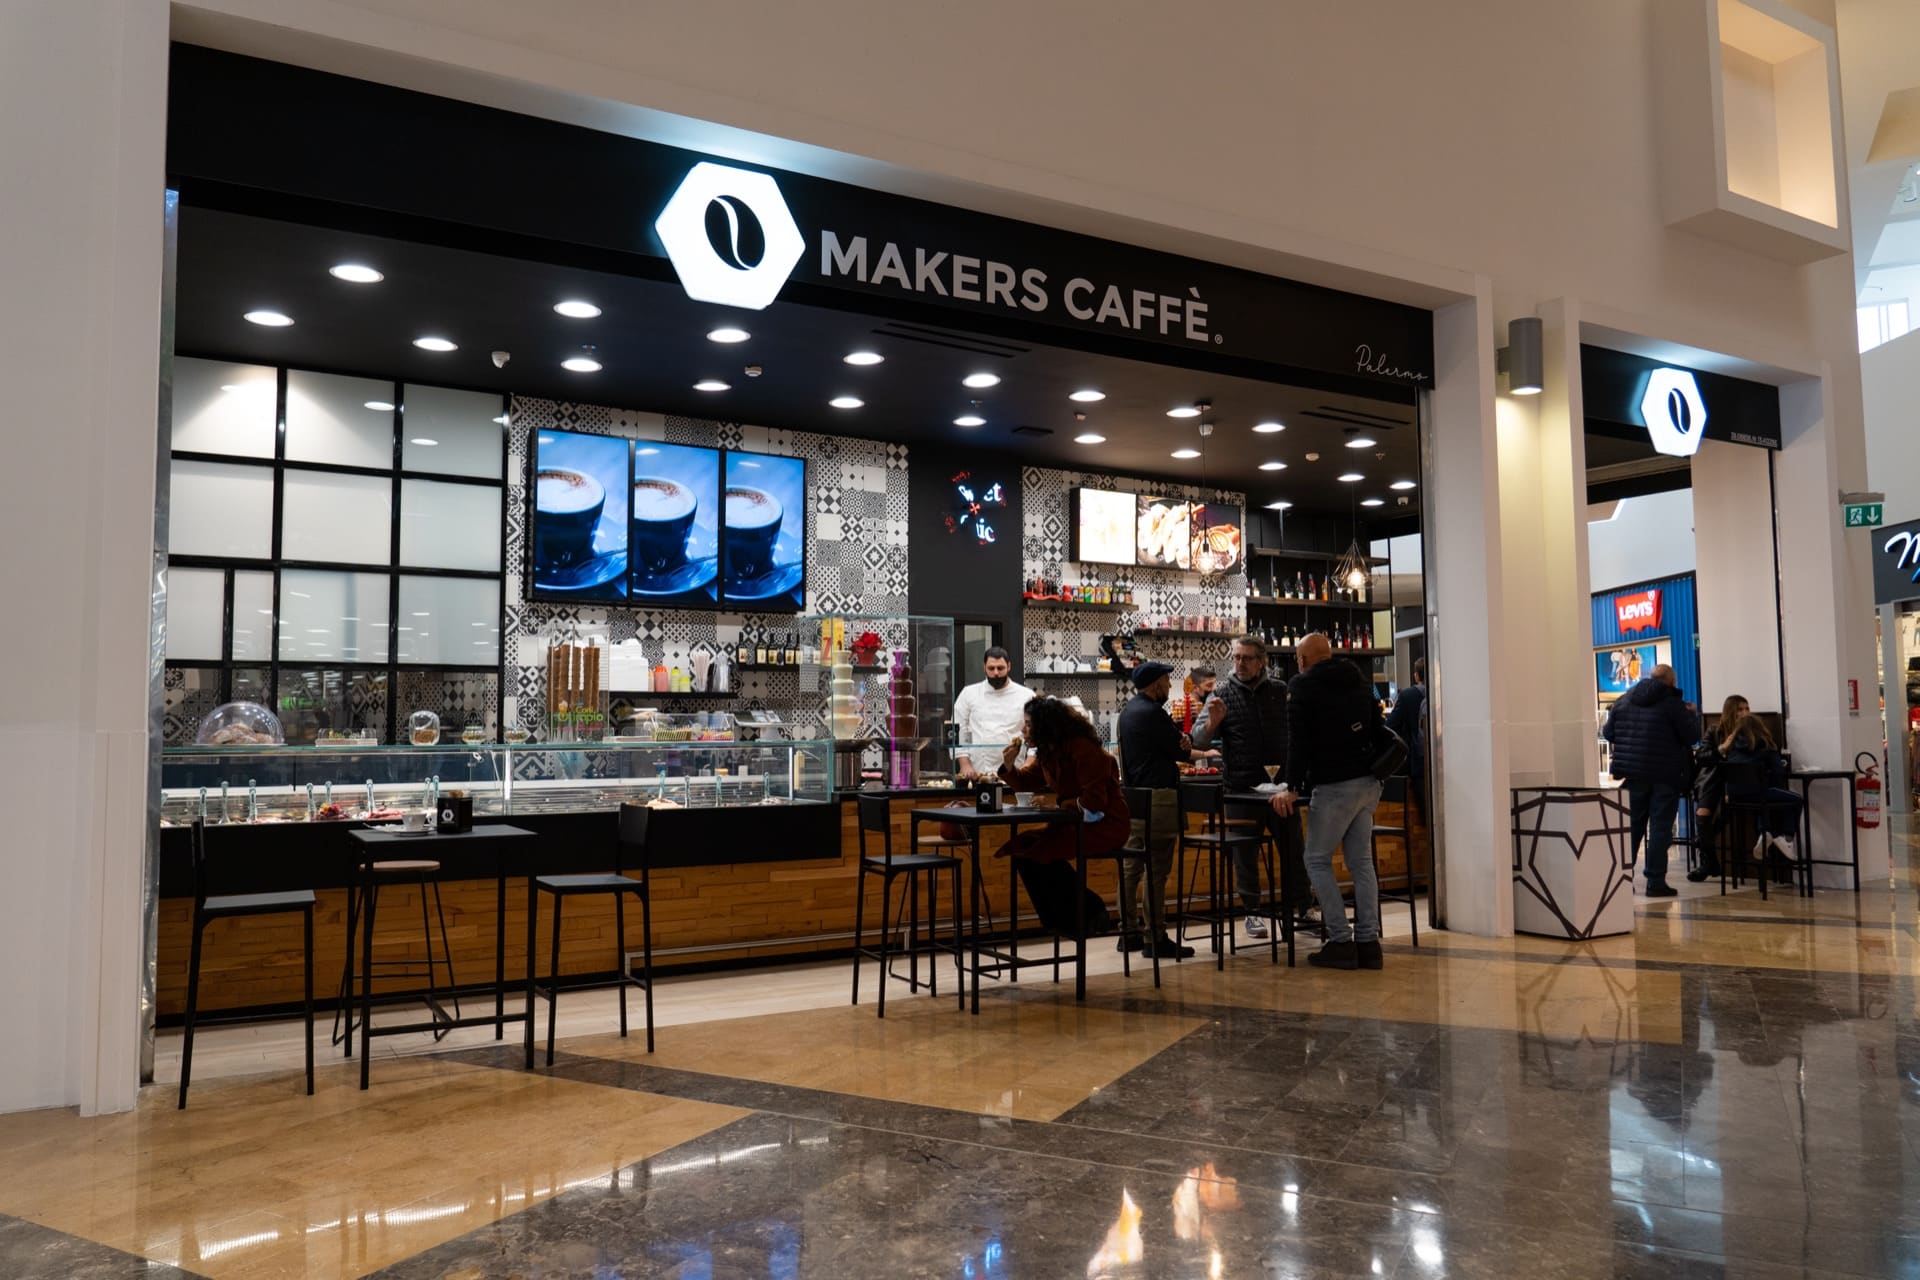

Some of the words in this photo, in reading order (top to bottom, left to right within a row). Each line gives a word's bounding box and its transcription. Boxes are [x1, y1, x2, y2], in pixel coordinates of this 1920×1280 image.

[821, 230, 1049, 312] MAKERS
[1063, 277, 1209, 342] CAFFÈ
[1355, 344, 1429, 380] Palermo
